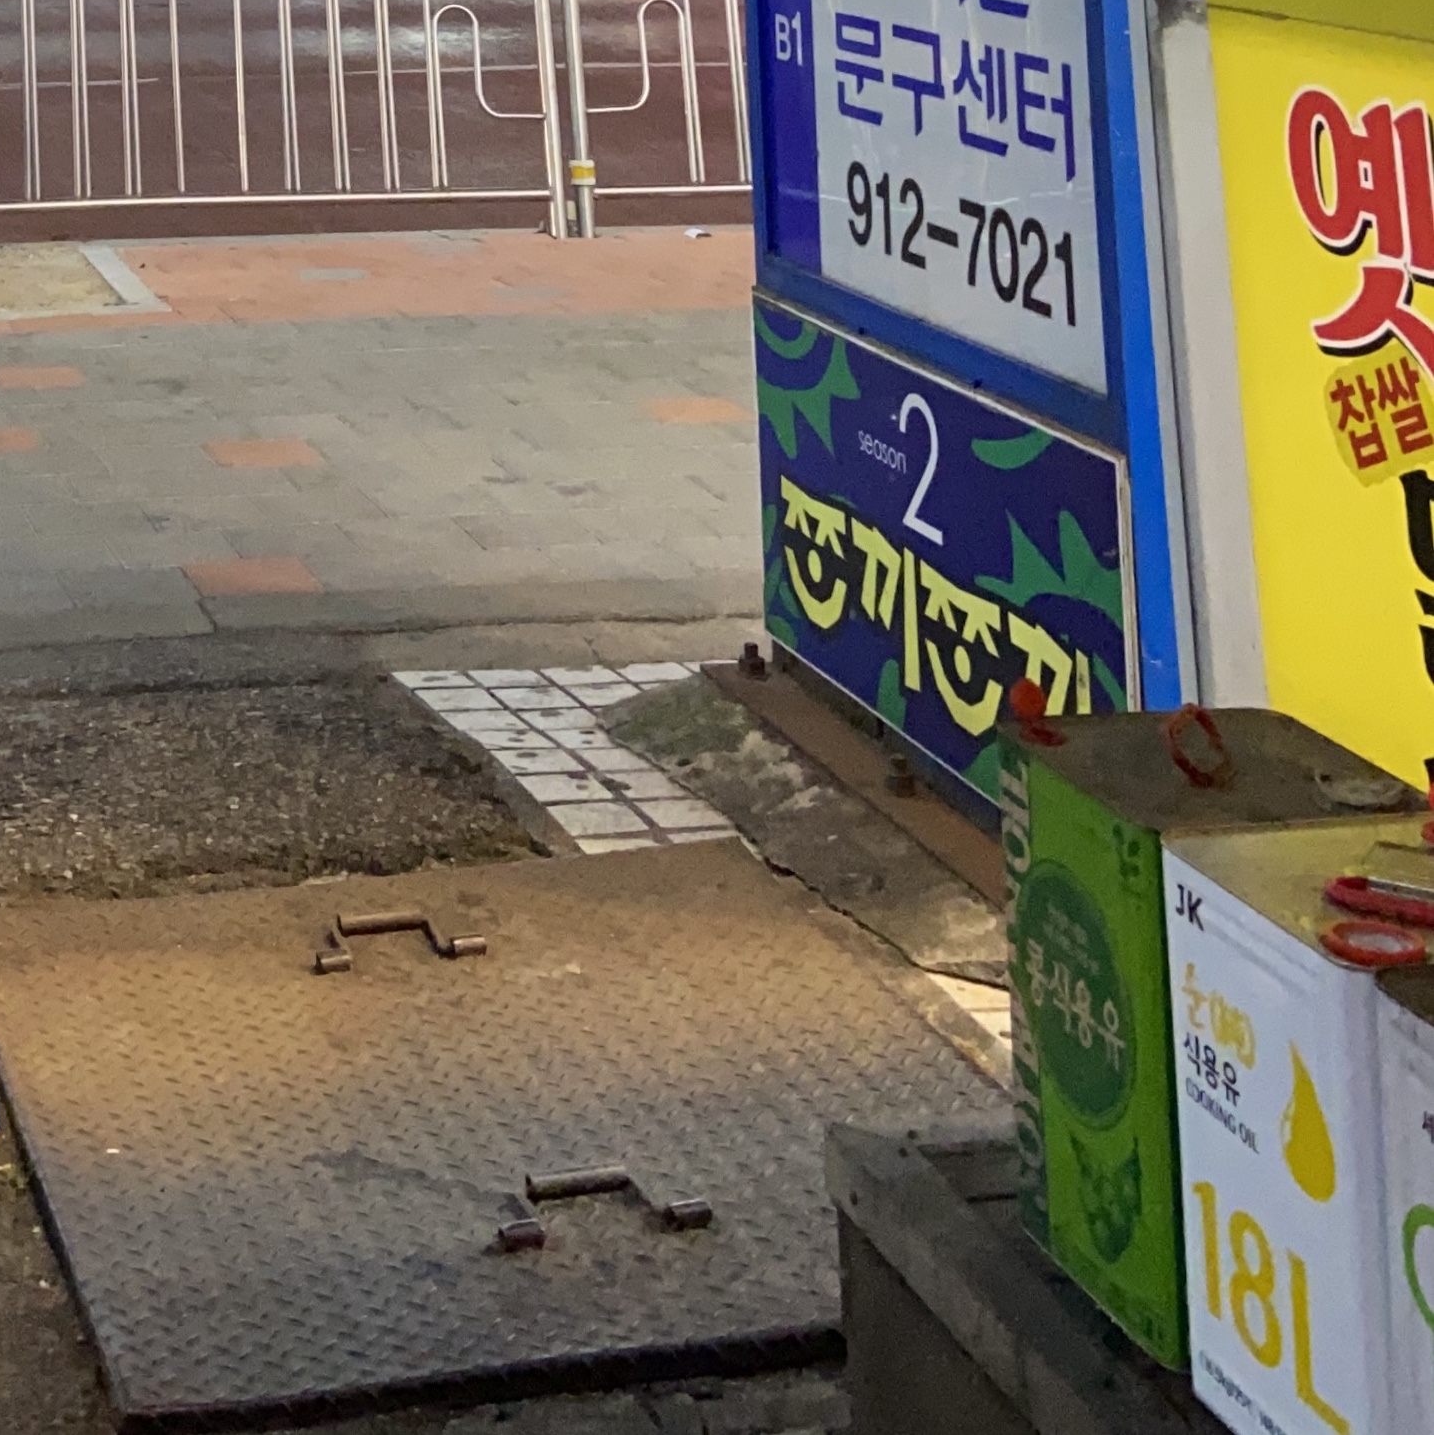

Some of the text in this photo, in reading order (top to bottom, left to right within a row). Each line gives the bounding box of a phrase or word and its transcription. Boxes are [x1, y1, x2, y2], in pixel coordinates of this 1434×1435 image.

[774, 11, 804, 66] B1
[834, 12, 1076, 183] 문구센터
[846, 161, 1077, 327] 912-7021
[858, 428, 907, 475] season
[1329, 357, 1434, 469] 찹쌀
[899, 393, 944, 546] 2
[1175, 883, 1205, 933] JK
[1183, 1031, 1241, 1108] 식용유
[1185, 1076, 1261, 1156] COOKING OIL
[1192, 1181, 1351, 1435] 18L
